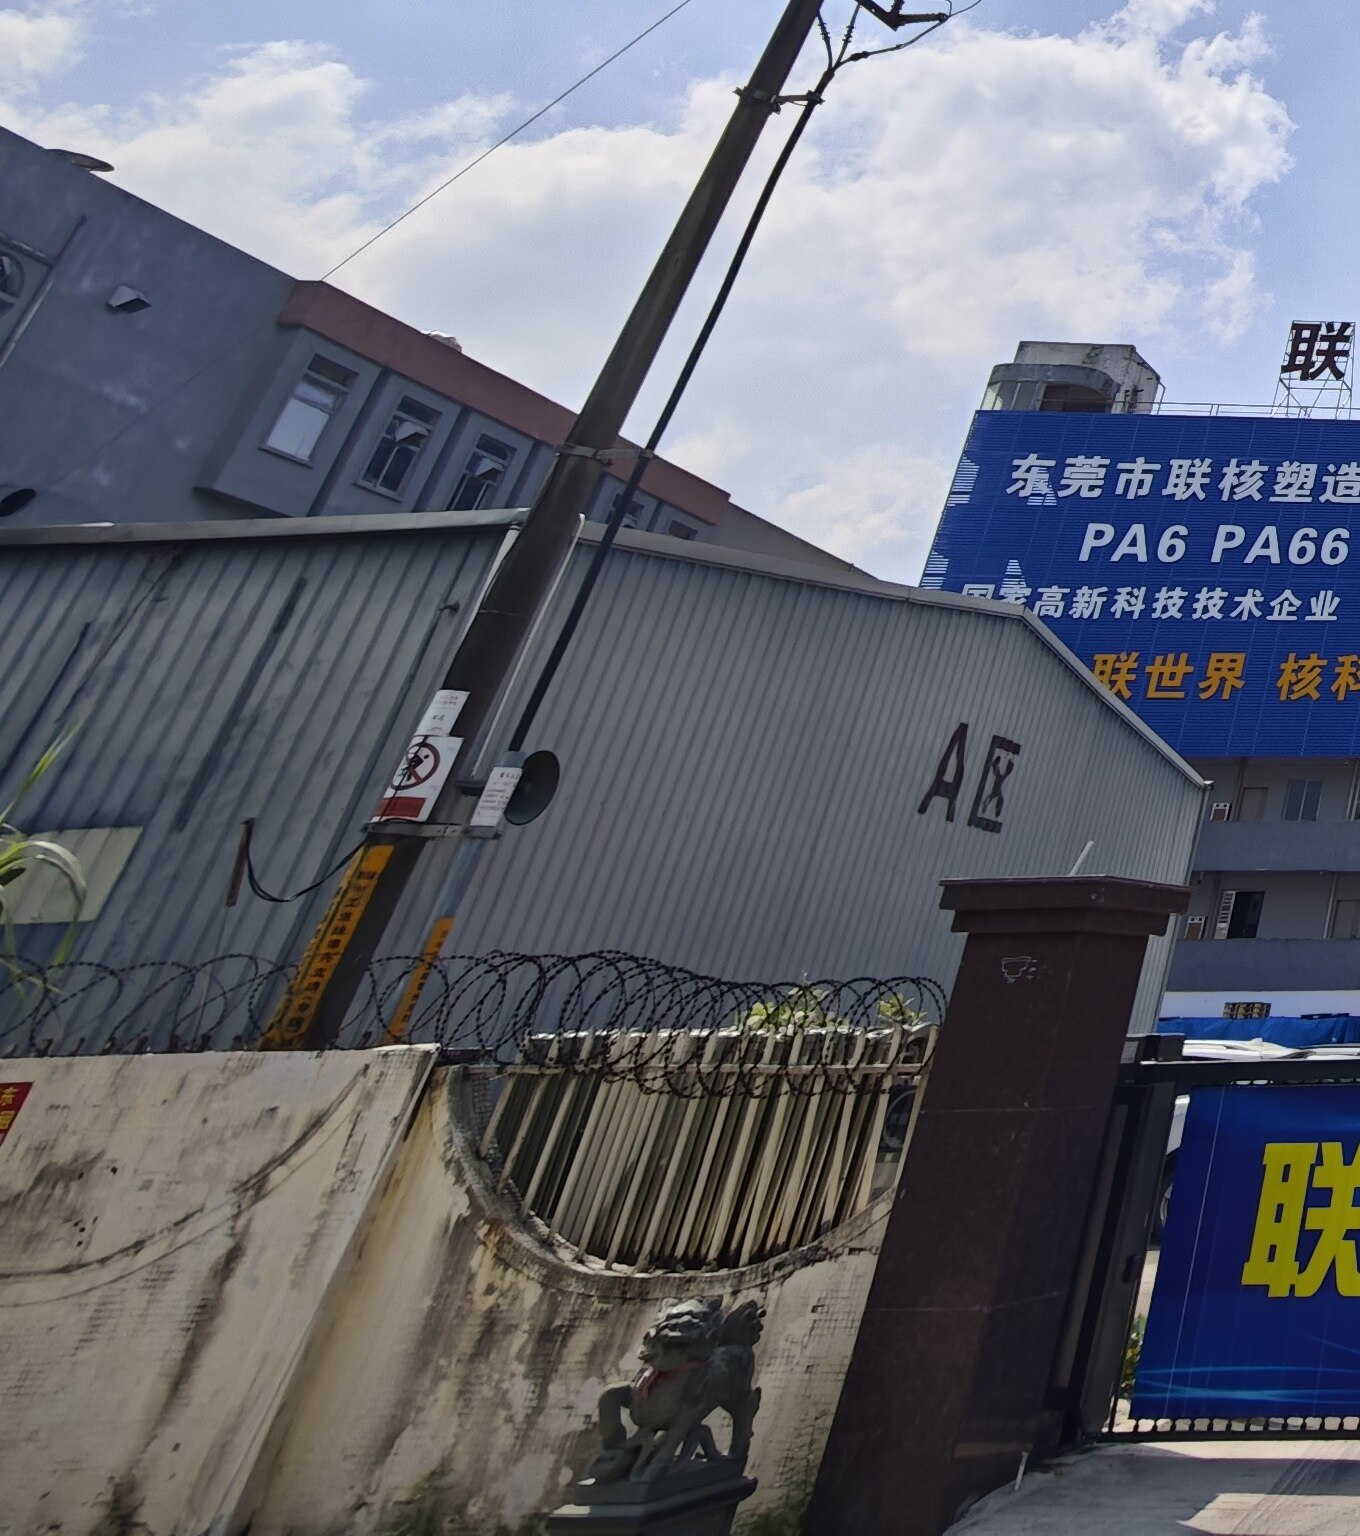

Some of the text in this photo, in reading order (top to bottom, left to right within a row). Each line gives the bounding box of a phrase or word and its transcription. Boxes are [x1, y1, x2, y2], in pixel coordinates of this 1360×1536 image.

[1078, 522, 1189, 563] PA6
[1210, 524, 1348, 566] PA66
[1092, 651, 1247, 700] 联世界
